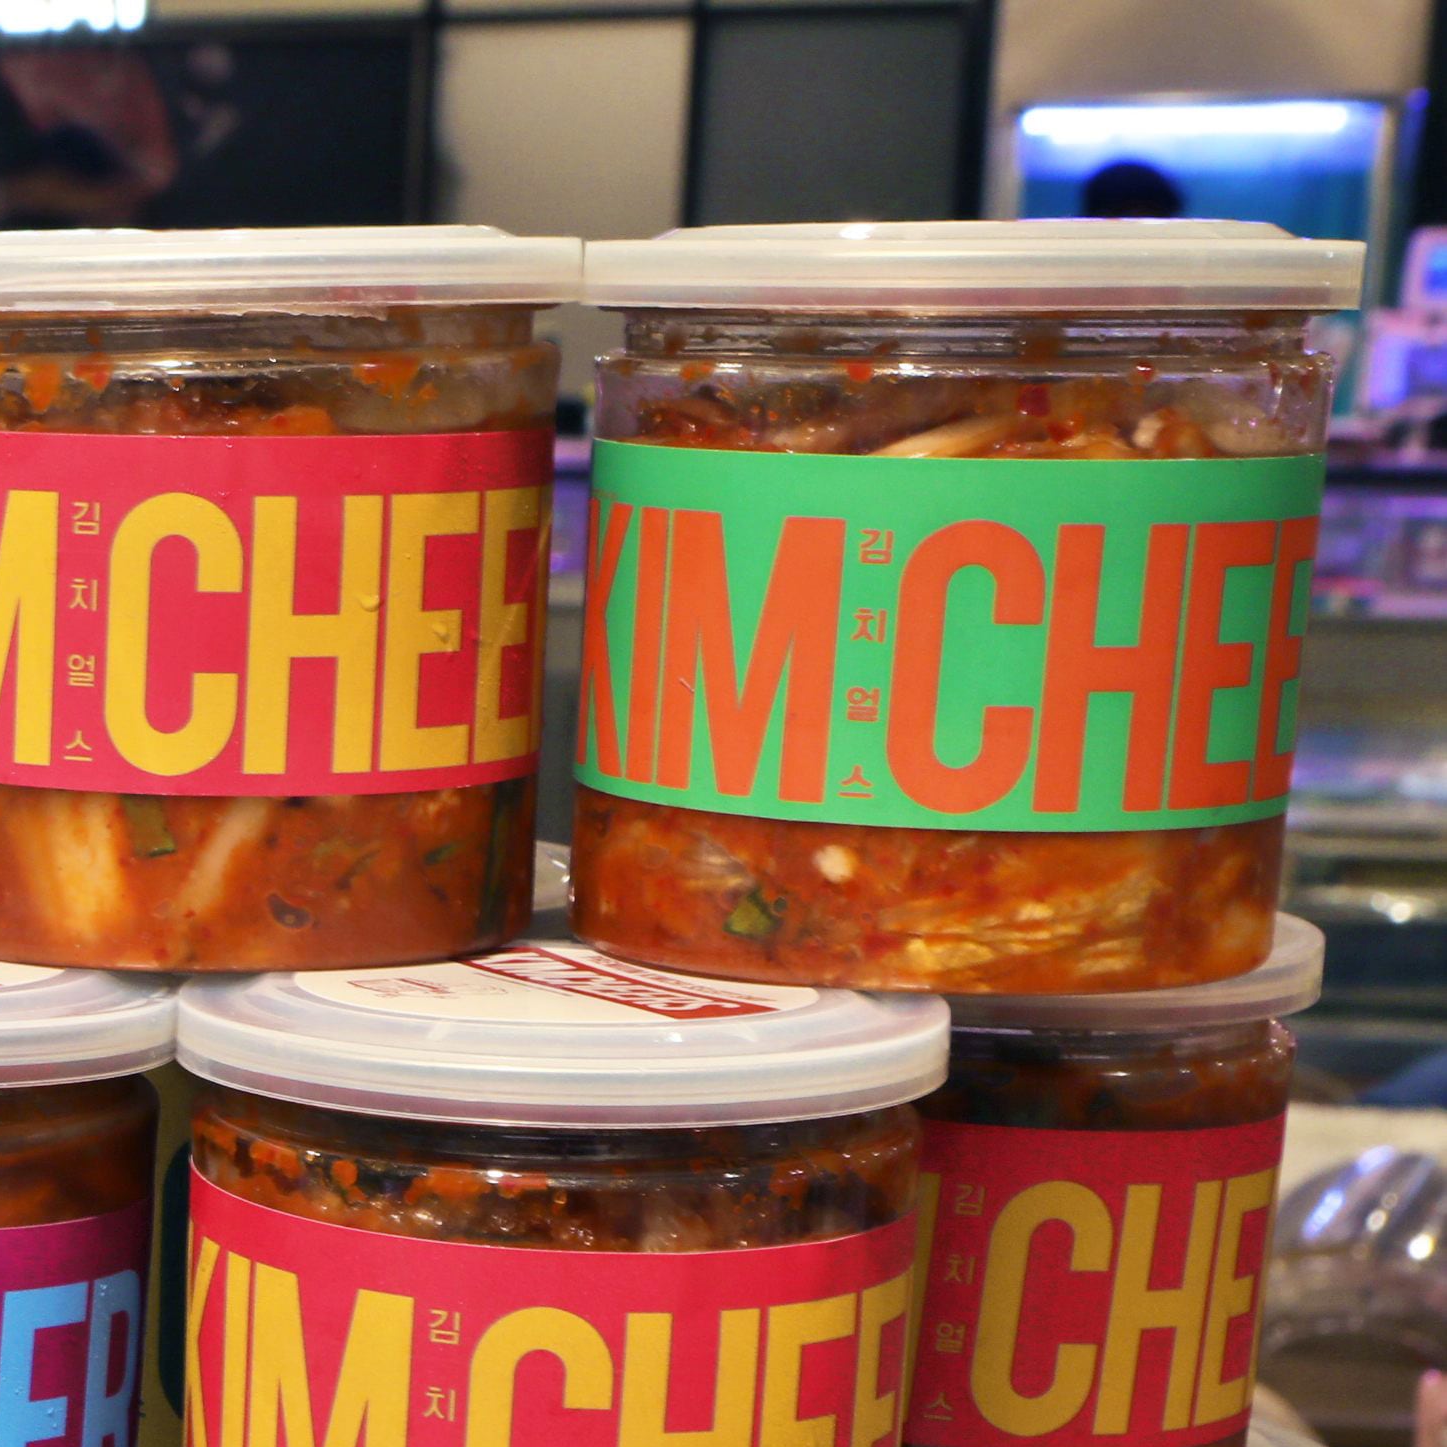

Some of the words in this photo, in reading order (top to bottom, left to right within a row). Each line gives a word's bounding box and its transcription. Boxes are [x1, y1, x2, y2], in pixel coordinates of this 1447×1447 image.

[63, 500, 102, 764] 김치얼스
[104, 486, 551, 777] CHEE
[838, 528, 894, 800] 김치얼스
[923, 1183, 986, 1421] 김치얼스
